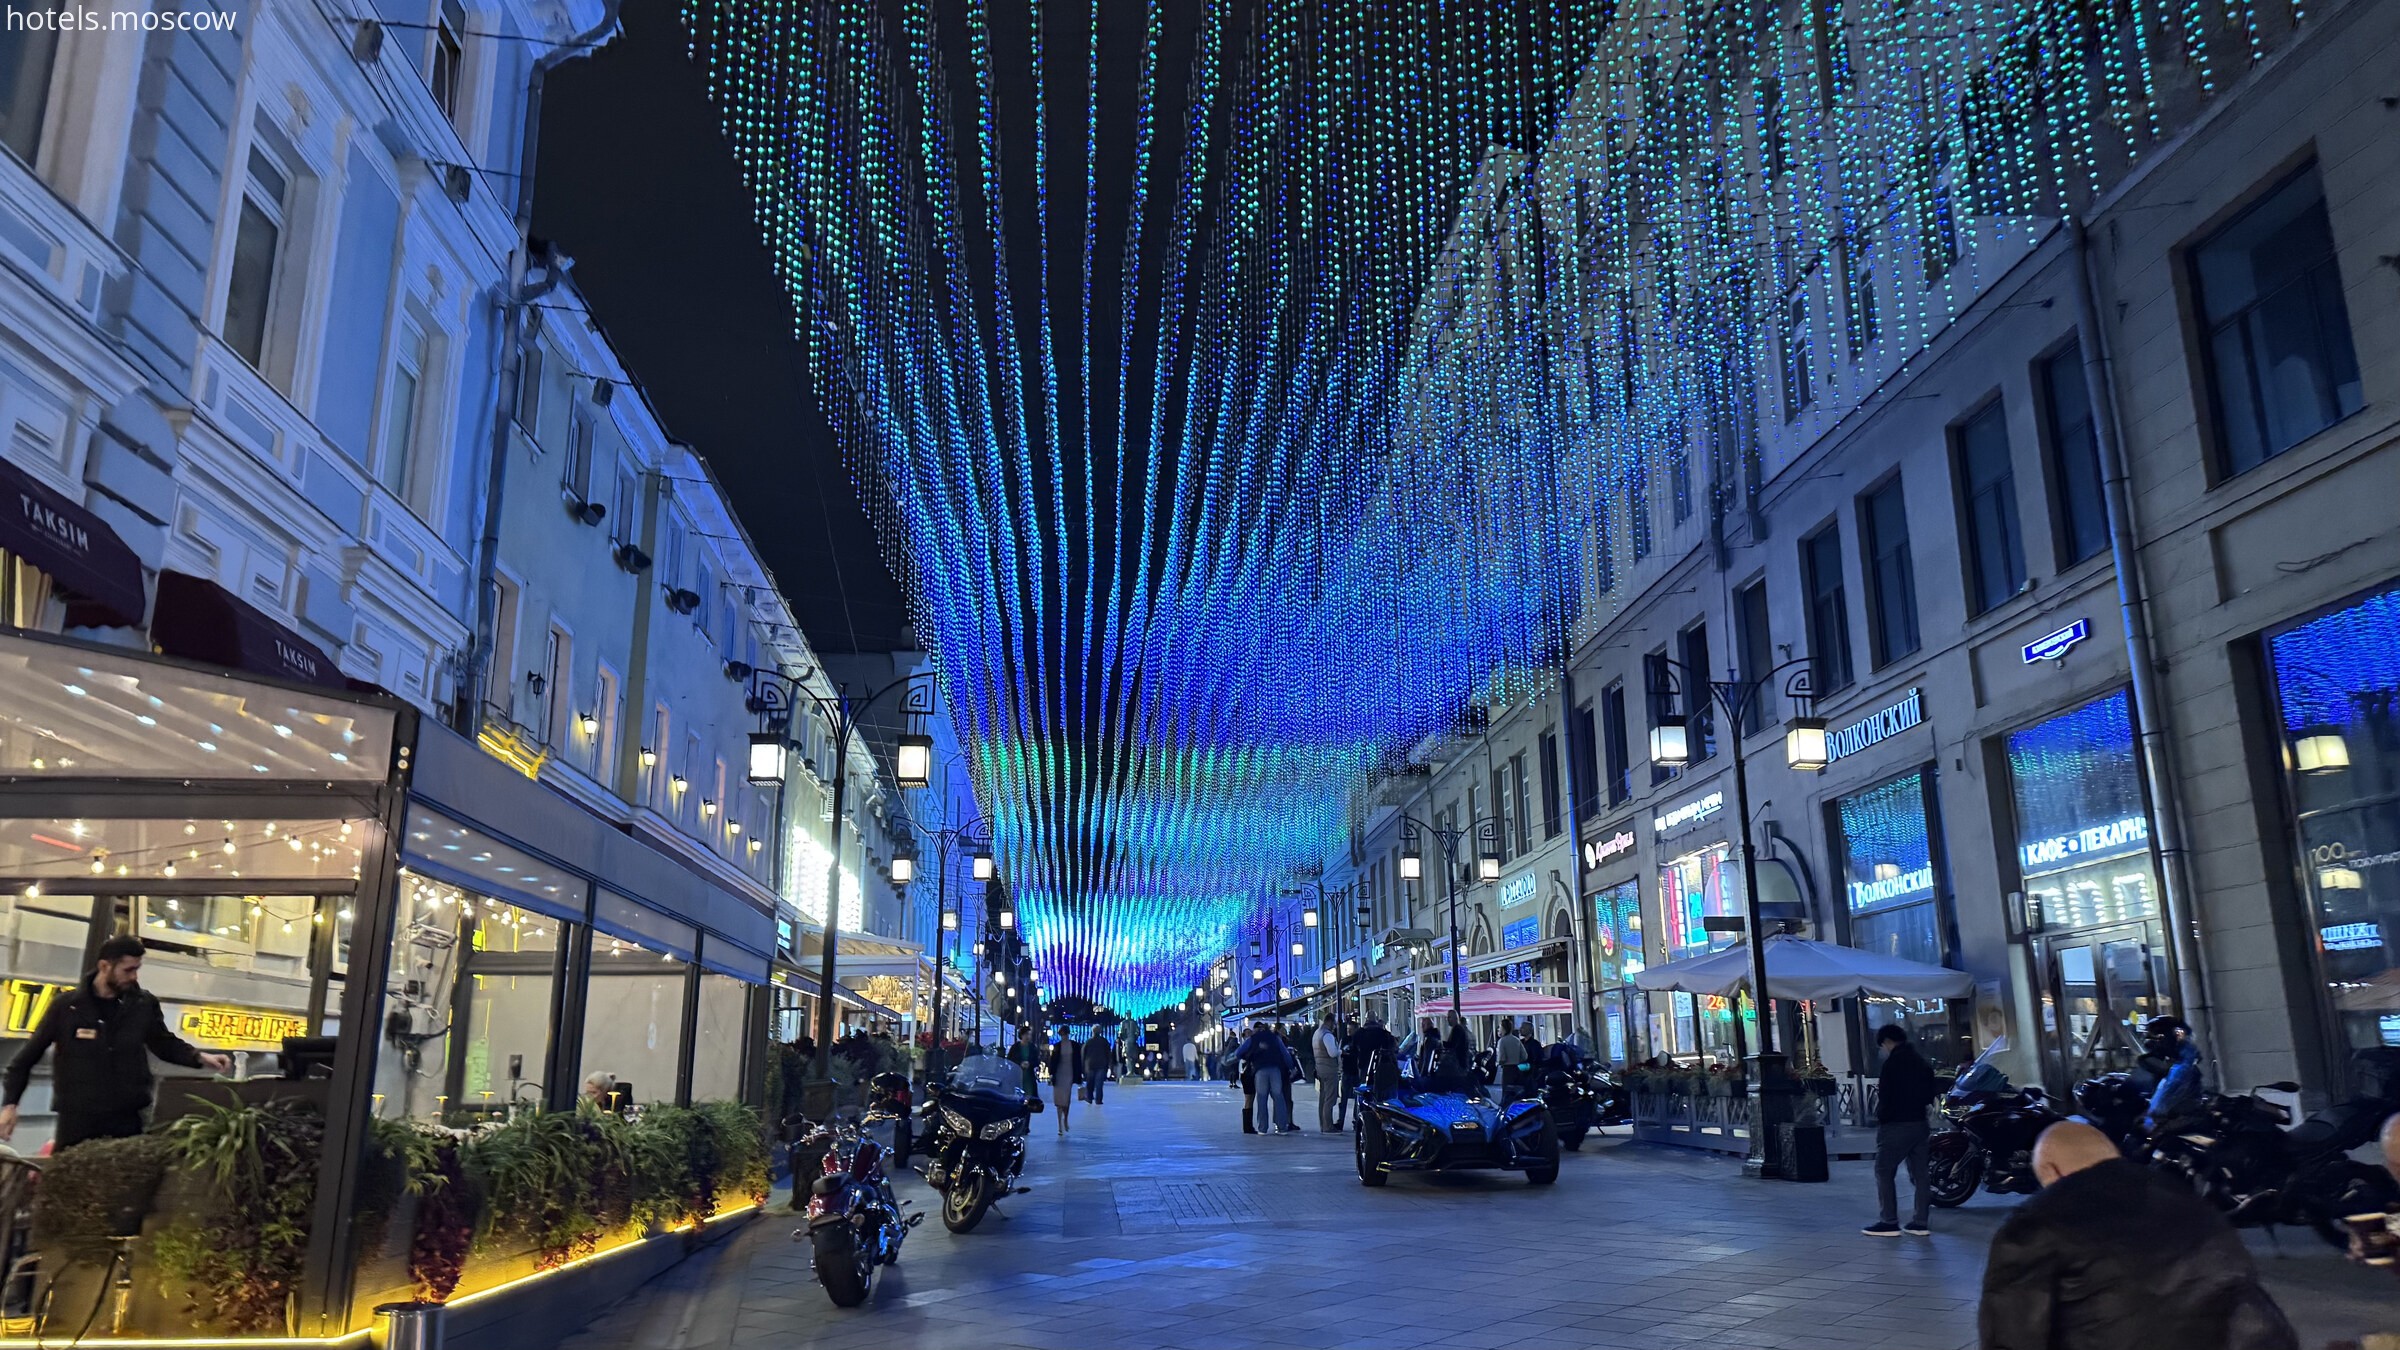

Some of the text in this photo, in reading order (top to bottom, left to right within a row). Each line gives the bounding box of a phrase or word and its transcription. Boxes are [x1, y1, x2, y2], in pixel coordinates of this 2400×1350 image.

[19, 492, 90, 553] TAKSIM
[275, 639, 317, 677] TAKSIM
[1825, 687, 1923, 764] ВОЛКОНСКИЙ
[2026, 836, 2069, 866] КАФЕ
